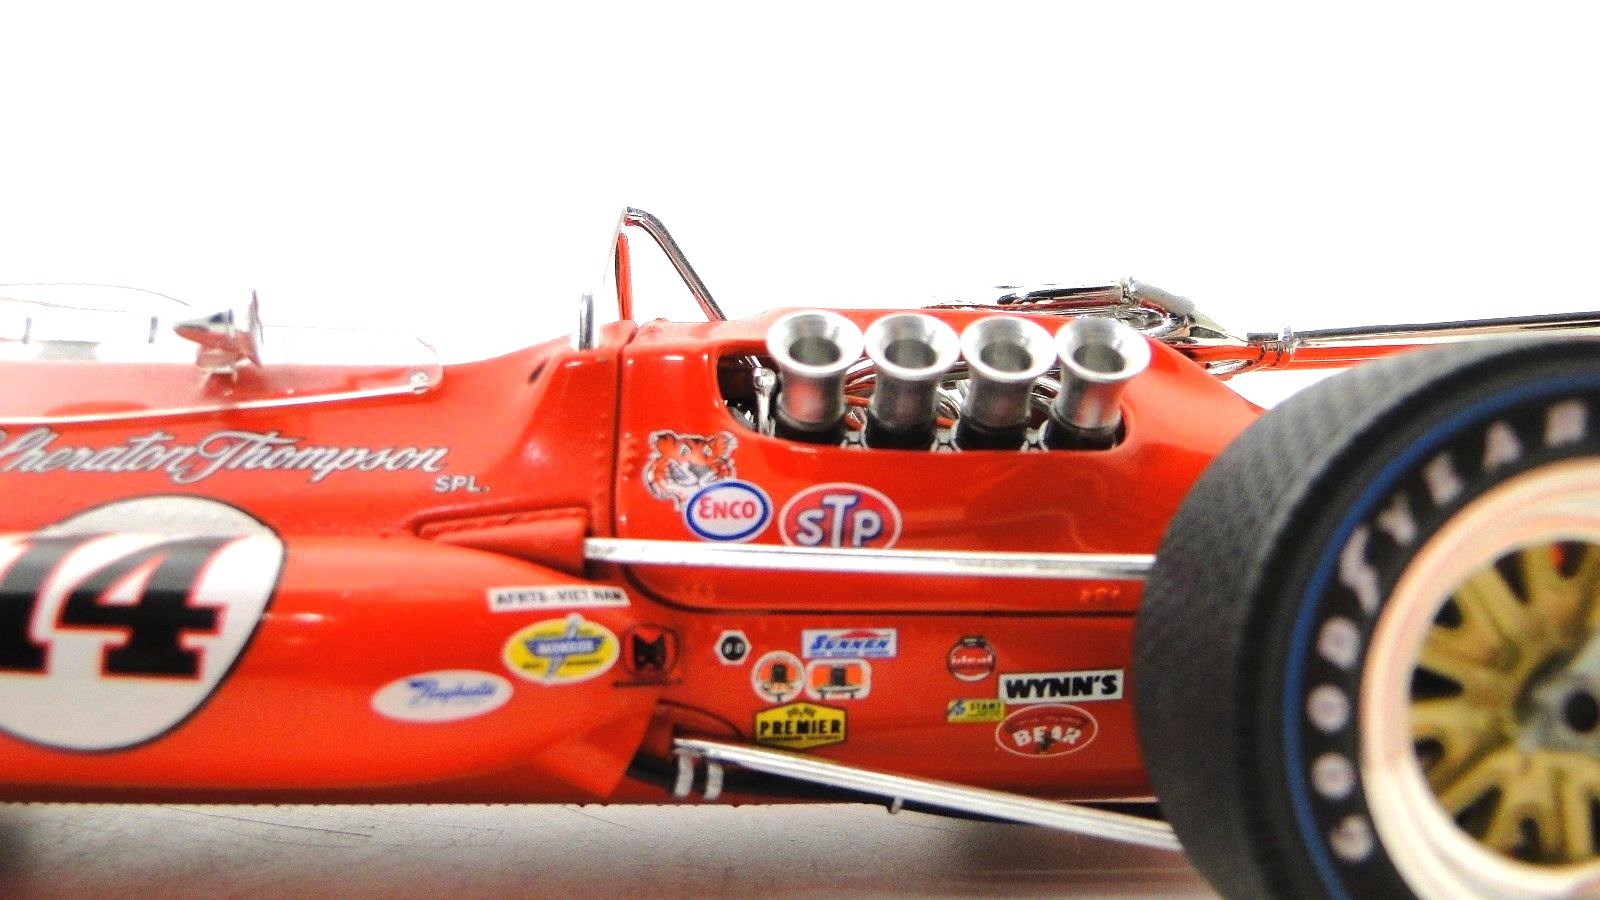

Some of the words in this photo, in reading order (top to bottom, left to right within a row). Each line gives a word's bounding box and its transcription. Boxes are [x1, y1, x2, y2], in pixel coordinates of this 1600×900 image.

[0, 427, 200, 474] heraton
[172, 429, 450, 485] Thompson
[434, 475, 490, 493] SPL.
[699, 497, 756, 519] ENCO
[796, 494, 883, 548] STP
[1005, 674, 1118, 699] WYNN'S
[759, 719, 842, 735] PREMIER
[1012, 725, 1083, 747] BEAR
